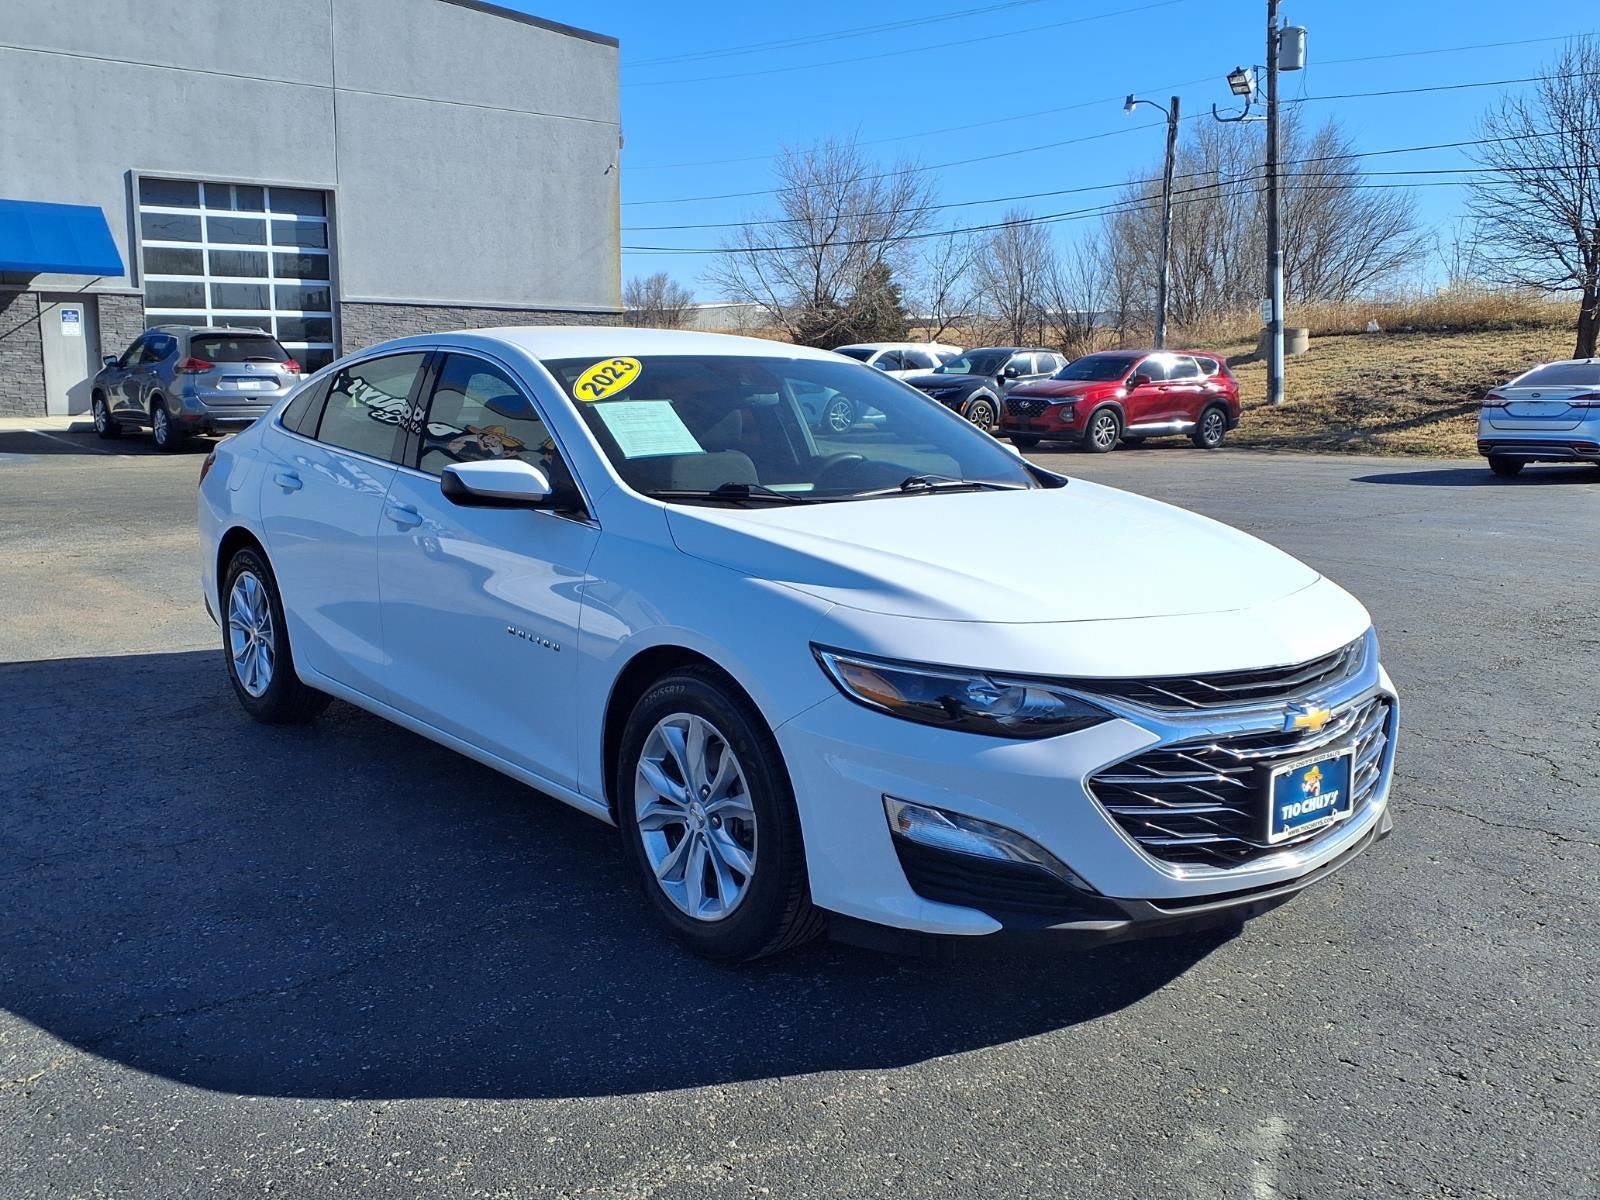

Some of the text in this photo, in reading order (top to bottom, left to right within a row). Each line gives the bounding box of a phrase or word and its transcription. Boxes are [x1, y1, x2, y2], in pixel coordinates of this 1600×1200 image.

[581, 360, 635, 397] 2023
[507, 626, 561, 652] MALIBU
[1281, 789, 1339, 820] TIO CHUY'S
